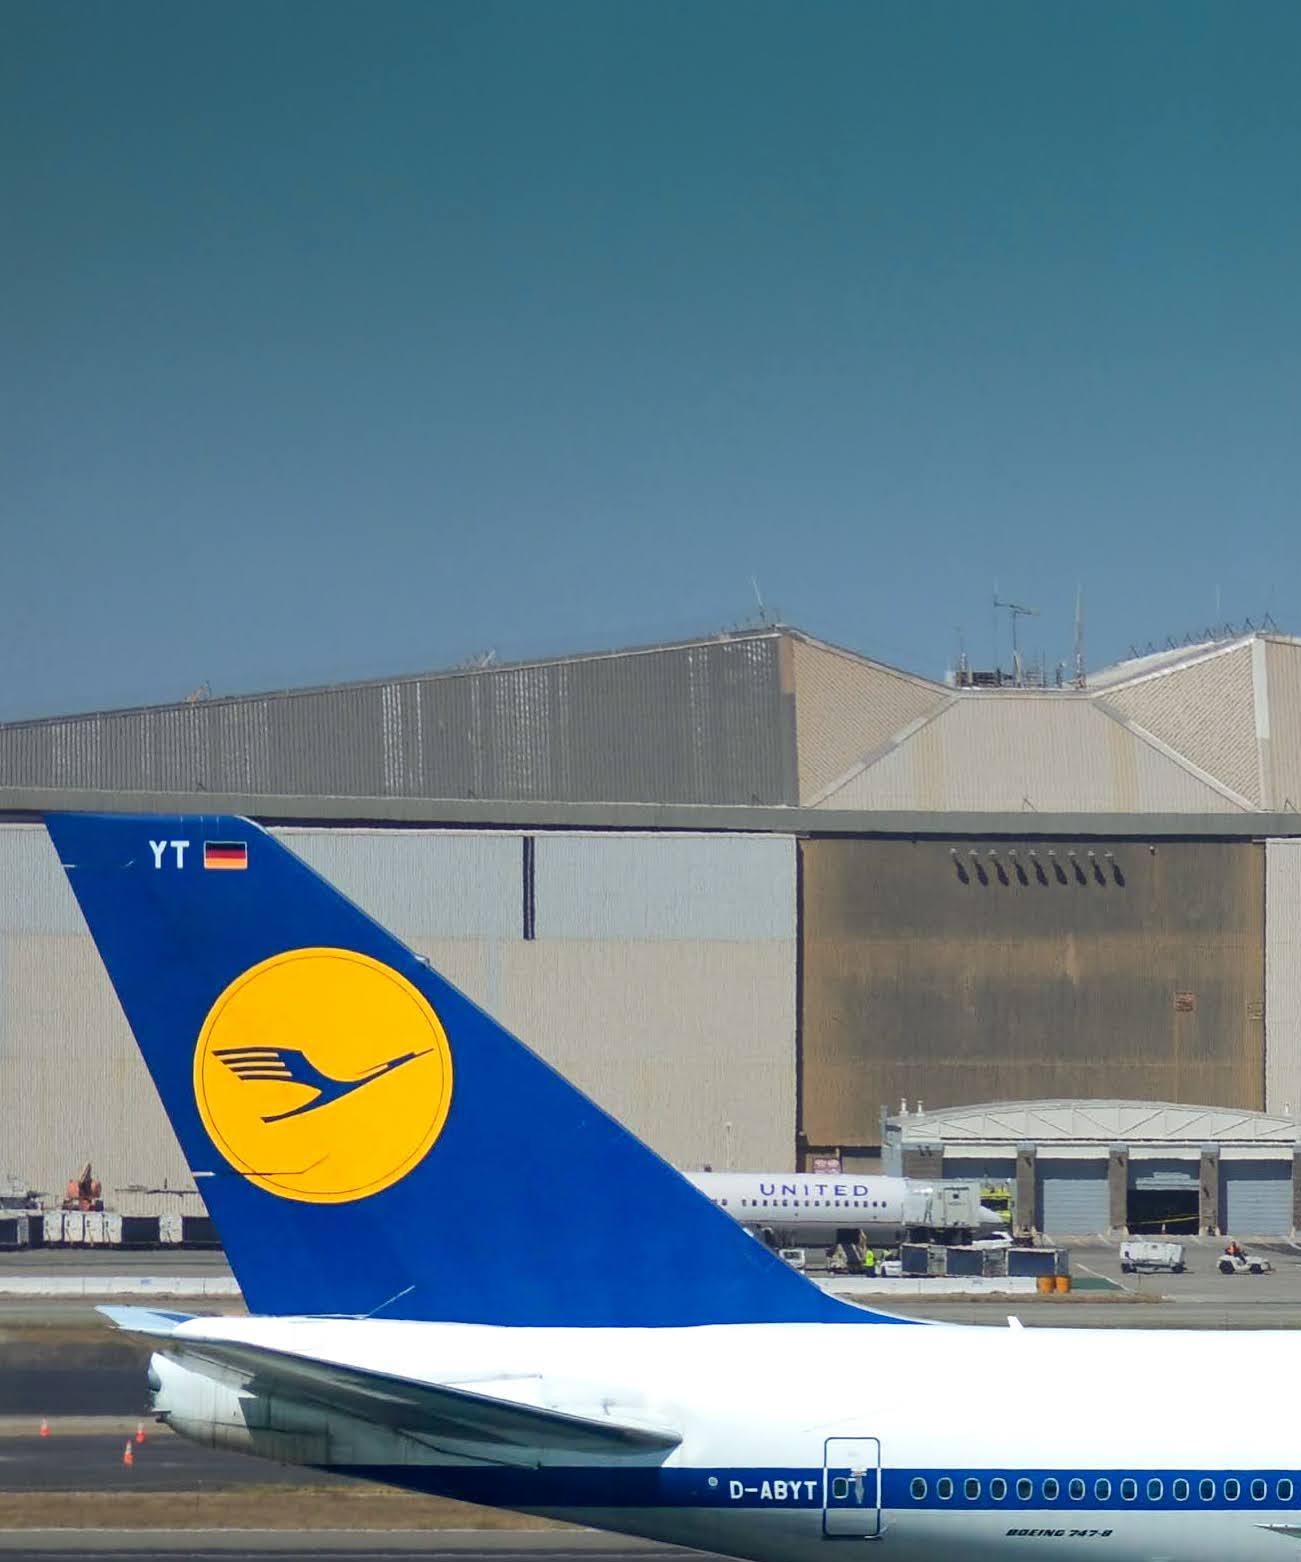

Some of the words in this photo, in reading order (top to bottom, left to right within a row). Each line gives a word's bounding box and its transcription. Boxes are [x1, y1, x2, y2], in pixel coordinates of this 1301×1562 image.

[148, 839, 190, 870] YT
[759, 1183, 869, 1197] UNITED
[728, 1480, 818, 1500] D-ABYT
[1005, 1528, 1066, 1537] BOEING
[1068, 1529, 1114, 1537] 747-8
